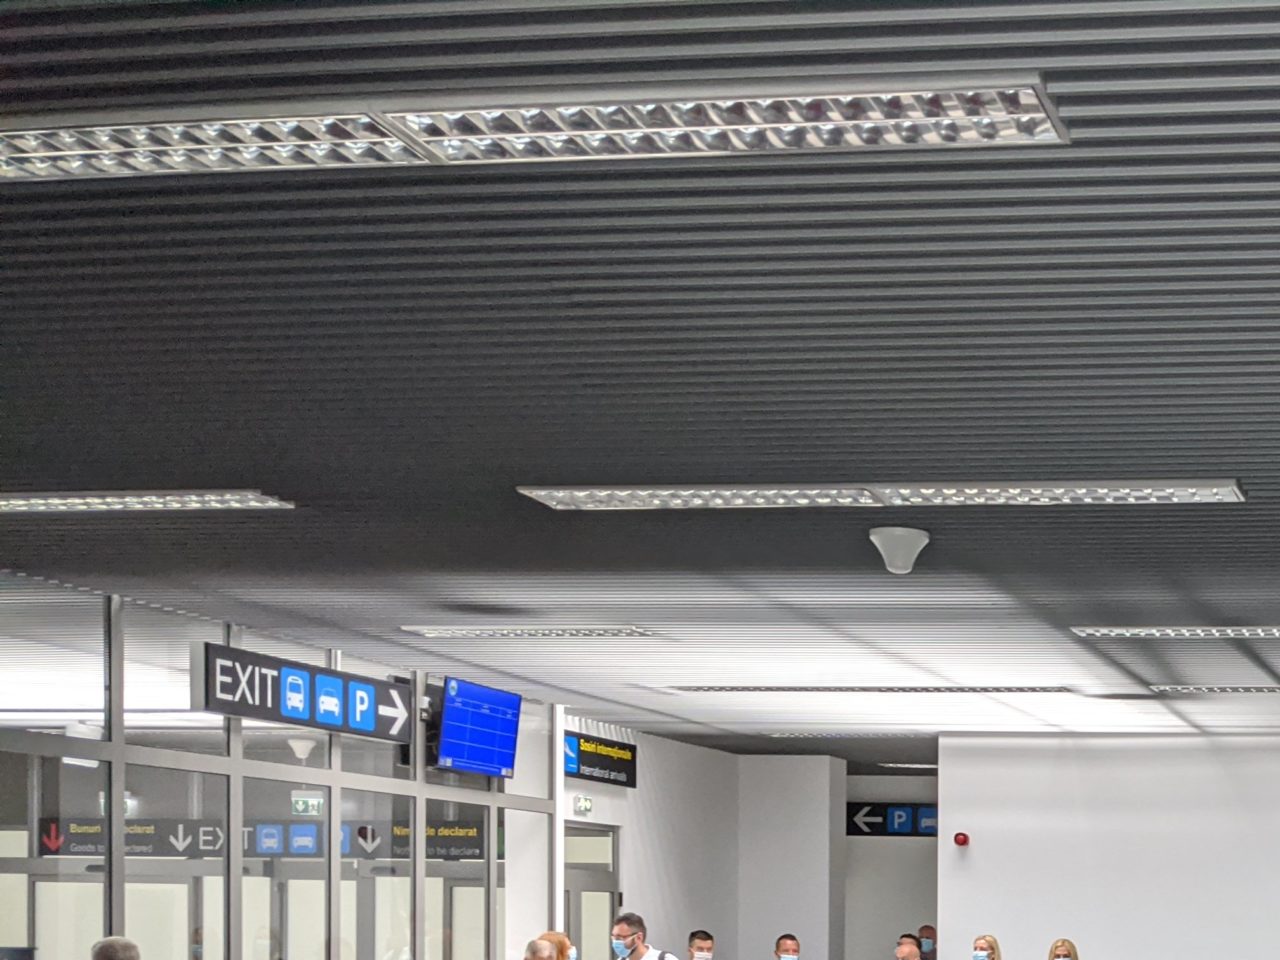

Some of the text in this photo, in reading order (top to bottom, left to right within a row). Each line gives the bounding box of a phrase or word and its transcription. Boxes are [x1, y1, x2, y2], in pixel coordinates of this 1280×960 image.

[214, 657, 369, 723] EXIT P
[893, 810, 907, 829] P
[199, 827, 254, 850] EXT
